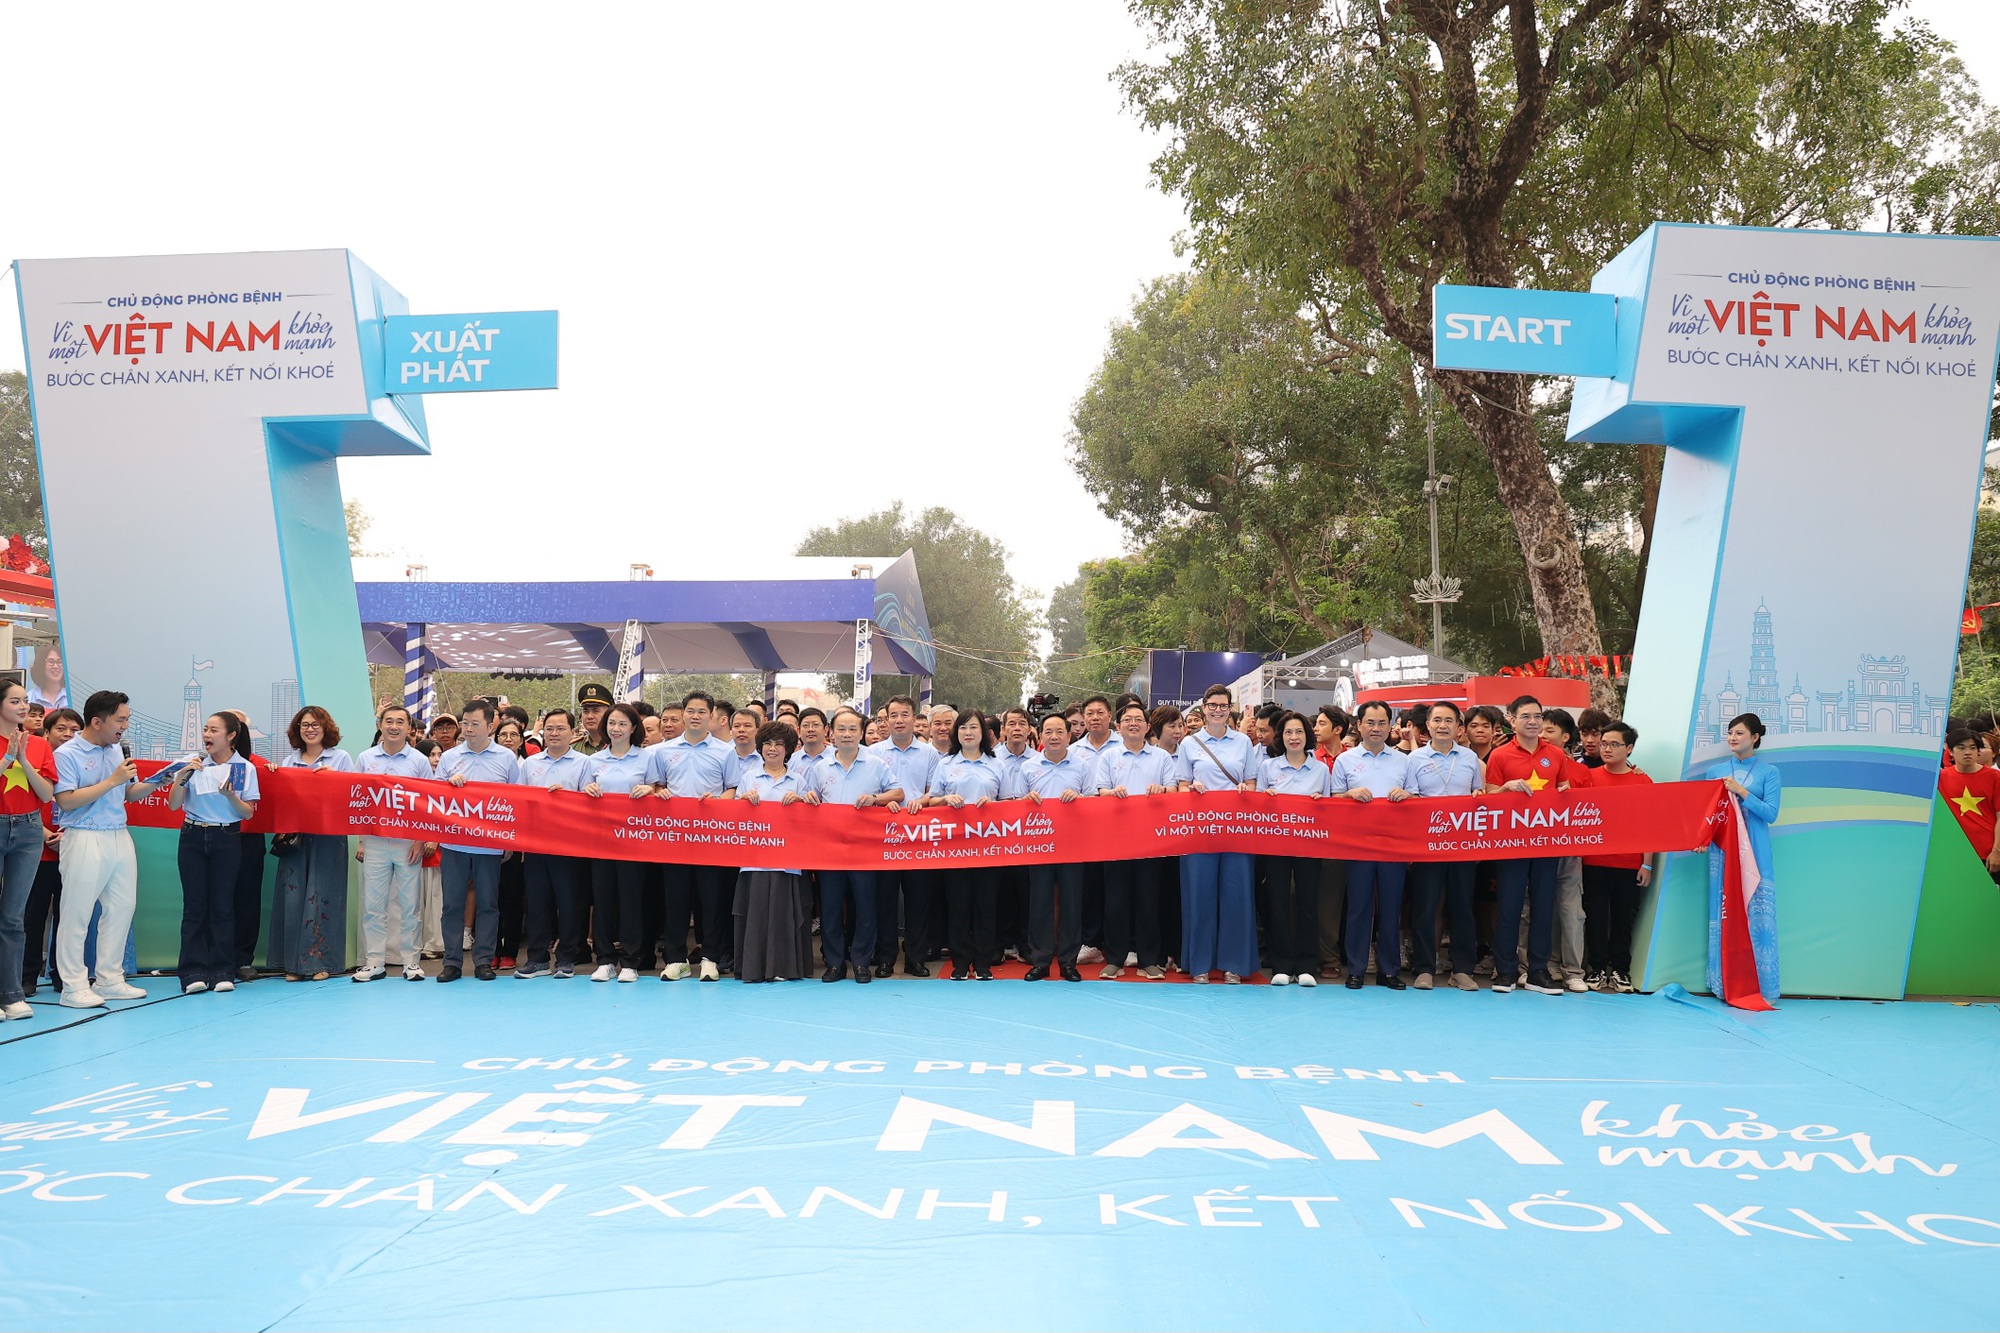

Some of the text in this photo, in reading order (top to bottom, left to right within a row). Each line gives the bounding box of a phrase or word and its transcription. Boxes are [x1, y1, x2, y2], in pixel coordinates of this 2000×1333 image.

[1729, 270, 1915, 293] CHỦ ĐỘNG PHÒNG BỆNH
[108, 291, 282, 308] CHỦ ĐỘNG PHÒNG BỆNH
[1673, 294, 1692, 316] Vì
[1446, 313, 1571, 345] START
[1668, 311, 1710, 340] một
[1703, 291, 1916, 347] VIỆT NAM
[54, 321, 73, 342] Vì
[83, 313, 280, 365] VIỆT NAM
[284, 333, 336, 354] mạnh
[411, 321, 500, 353] XUẤT
[1921, 327, 1977, 350] mạnh
[49, 338, 87, 364] một
[1668, 347, 1719, 365] BƯỚC
[1726, 351, 1778, 368] CHÂN
[1785, 355, 1842, 372] XANH,
[1849, 354, 1880, 372] KẾT
[1887, 356, 1919, 374] NỐI
[47, 370, 95, 386] BƯỚC
[101, 369, 149, 385] CHÂN
[155, 370, 208, 383] XANH,
[214, 363, 245, 381] KẾT
[250, 364, 281, 380] NỐI
[401, 353, 490, 383] PHÁT
[1401, 655, 1428, 667] NAM
[368, 784, 483, 819] VIỆT NAM
[445, 824, 462, 834] KẾT
[627, 815, 770, 833] CHỦ ĐỘNG PHÒNG BỆNH
[1169, 810, 1314, 825] CHỦ ĐỘNG PHÒNG BỆNH
[1449, 806, 1569, 836] VIỆT NAM
[614, 828, 625, 838] VÌ
[629, 829, 654, 840] MỘT
[657, 831, 681, 841] VIỆT
[685, 833, 710, 843] NAM
[750, 837, 784, 846] MẠNH
[903, 818, 1021, 846] VIỆT NAM
[1155, 826, 1166, 836] VÌ
[1170, 825, 1195, 836] MỘT
[1198, 824, 1223, 836] VIỆT
[1294, 829, 1328, 838] MẠNH
[1461, 839, 1491, 849] CHÂN
[1494, 839, 1527, 848] XANH,
[1530, 835, 1548, 846] KẾT
[949, 848, 980, 857] XANH,
[984, 845, 1001, 855] KẾT
[463, 1054, 1465, 1084] CHỦ ĐỘNG PHÒNG BỆNH
[246, 1077, 1564, 1166] VIỆT NAM
[1599, 1140, 1958, 1180] mạnh
[165, 1173, 569, 1215] CHÂN
[588, 1185, 1045, 1227] XANH,
[1099, 1186, 1339, 1227] KẾT
[1389, 1190, 1671, 1234] NỐI
